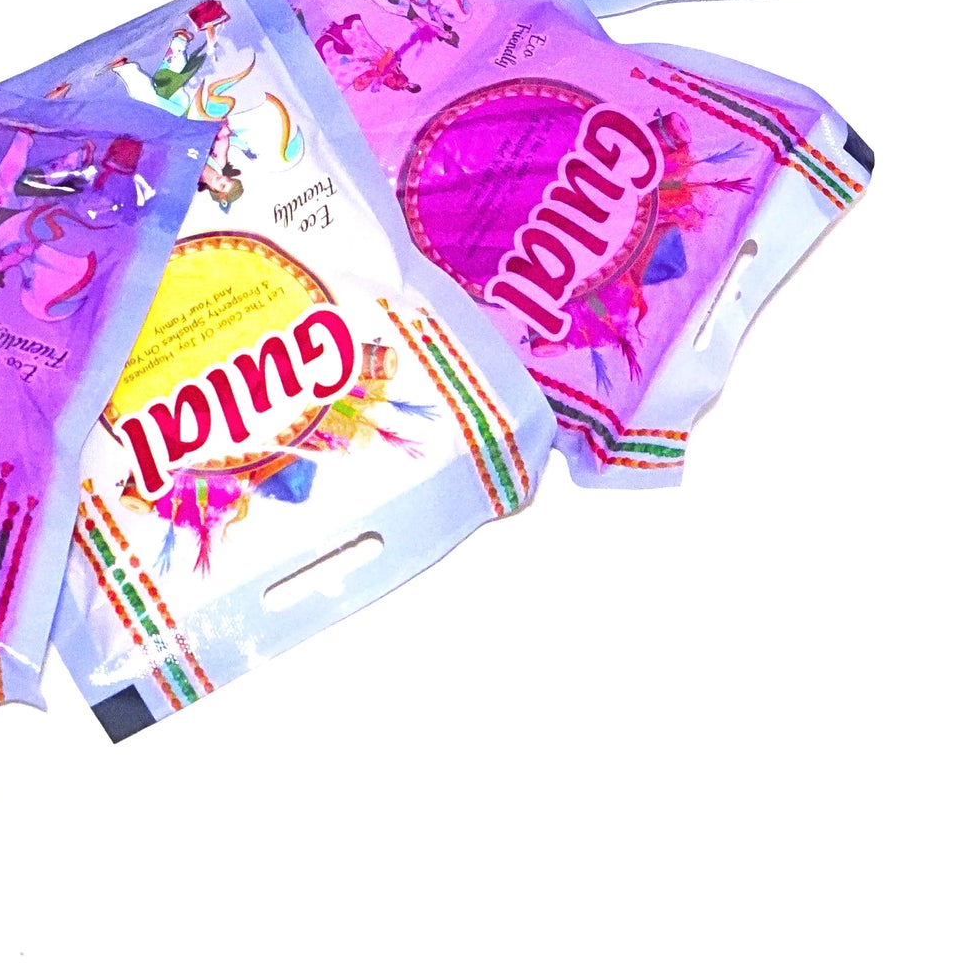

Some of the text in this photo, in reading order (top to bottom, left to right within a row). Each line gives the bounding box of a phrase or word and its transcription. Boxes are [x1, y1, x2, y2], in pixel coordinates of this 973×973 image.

[494, 22, 533, 68] Friendly
[523, 34, 547, 58] Eco
[273, 176, 338, 229] Friendly
[297, 203, 334, 233] Eco
[491, 109, 658, 335] Gulal
[207, 287, 261, 319] Prosperity
[245, 301, 264, 313] The
[267, 287, 285, 301] Let
[155, 287, 233, 335] And Your Family
[219, 311, 243, 329] Color
[161, 319, 205, 347] Splashes
[201, 329, 215, 341] Of
[145, 345, 159, 355] On
[123, 351, 173, 384] Happiness
[121, 310, 355, 494] Gulal
